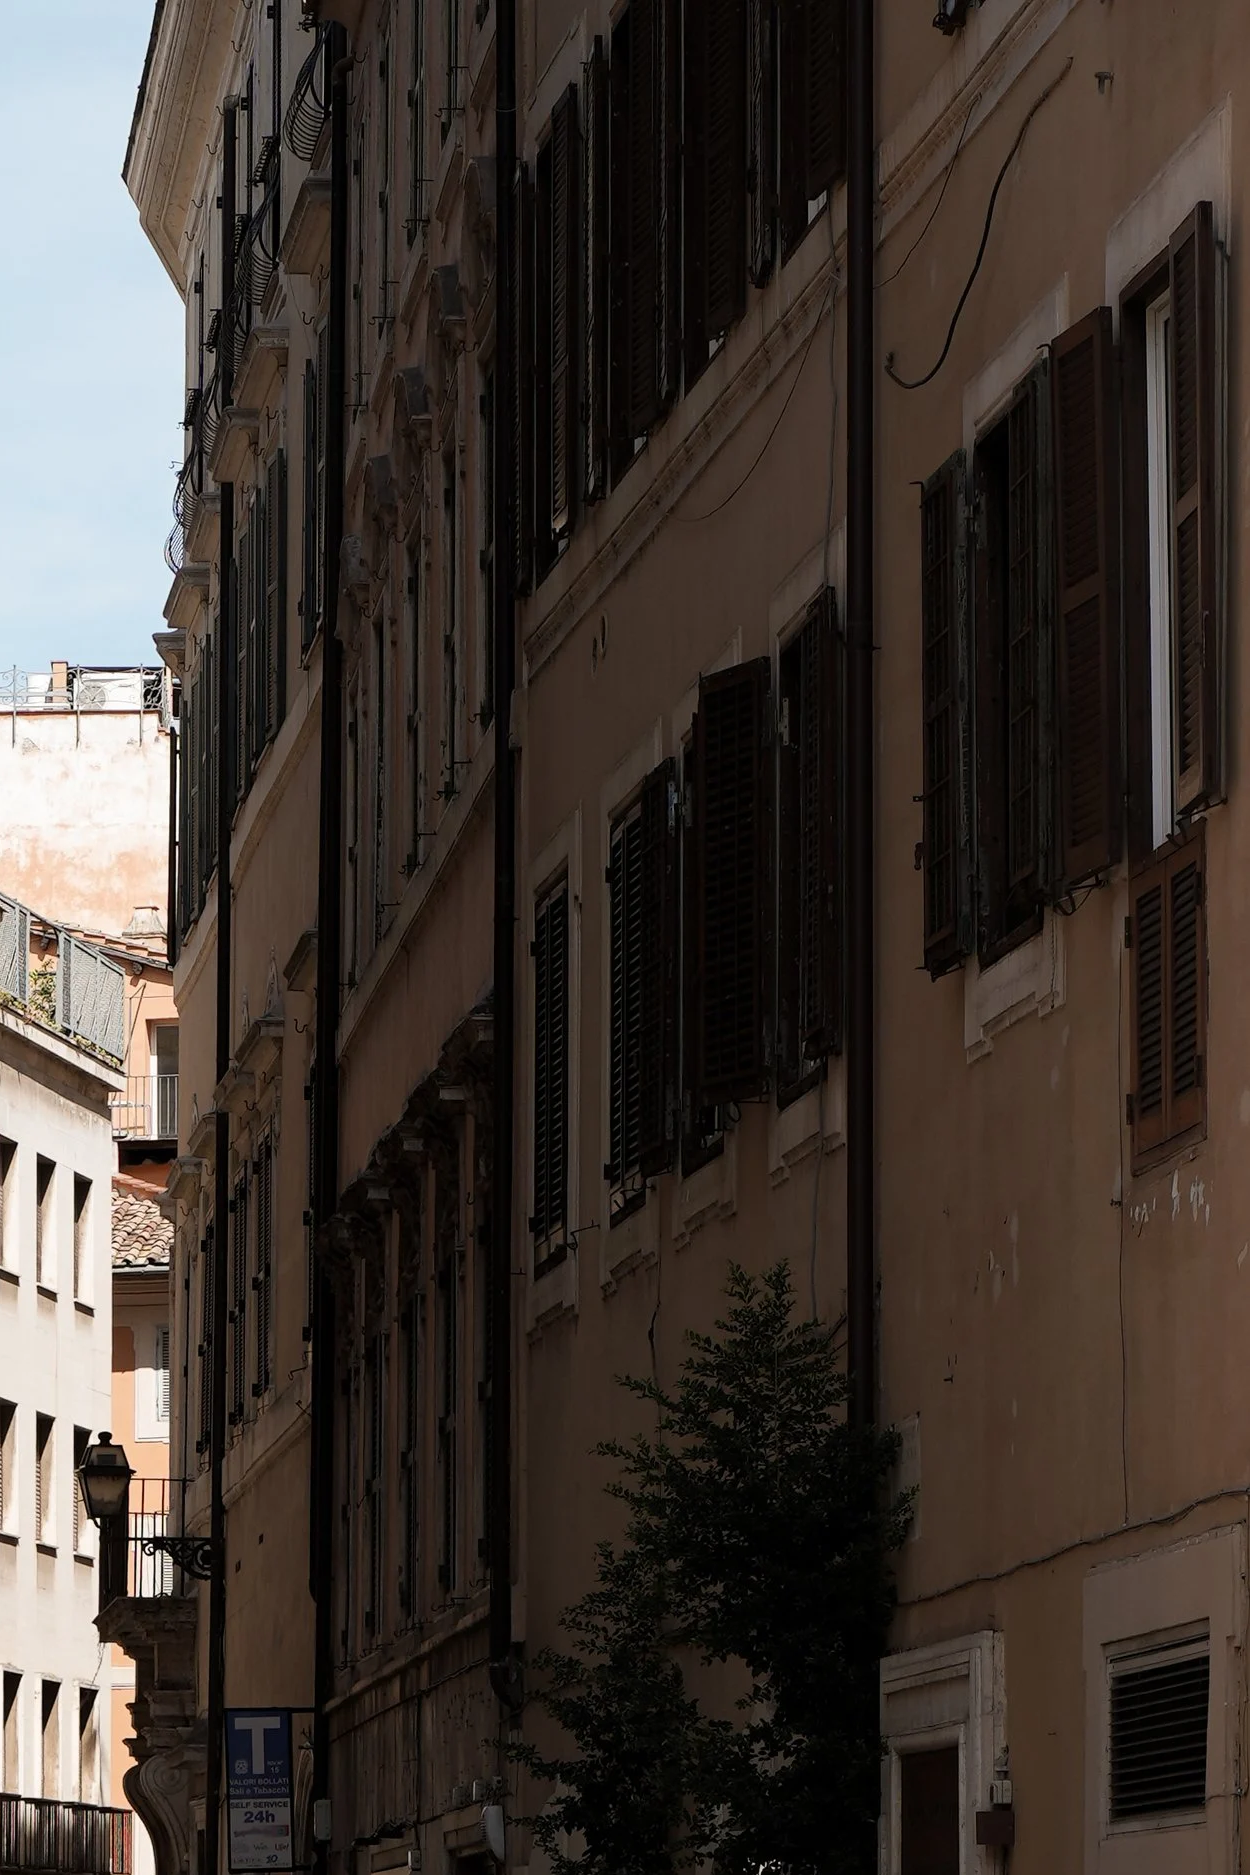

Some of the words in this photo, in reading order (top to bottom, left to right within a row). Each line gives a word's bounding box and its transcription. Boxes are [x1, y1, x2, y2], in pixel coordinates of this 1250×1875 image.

[234, 1716, 280, 1774] T
[229, 1777, 256, 1785] VALORI
[258, 1776, 289, 1785] BOLLATI
[229, 1787, 244, 1795] Sali
[253, 1786, 289, 1794] Tabacchi
[244, 1811, 275, 1823] 24h
